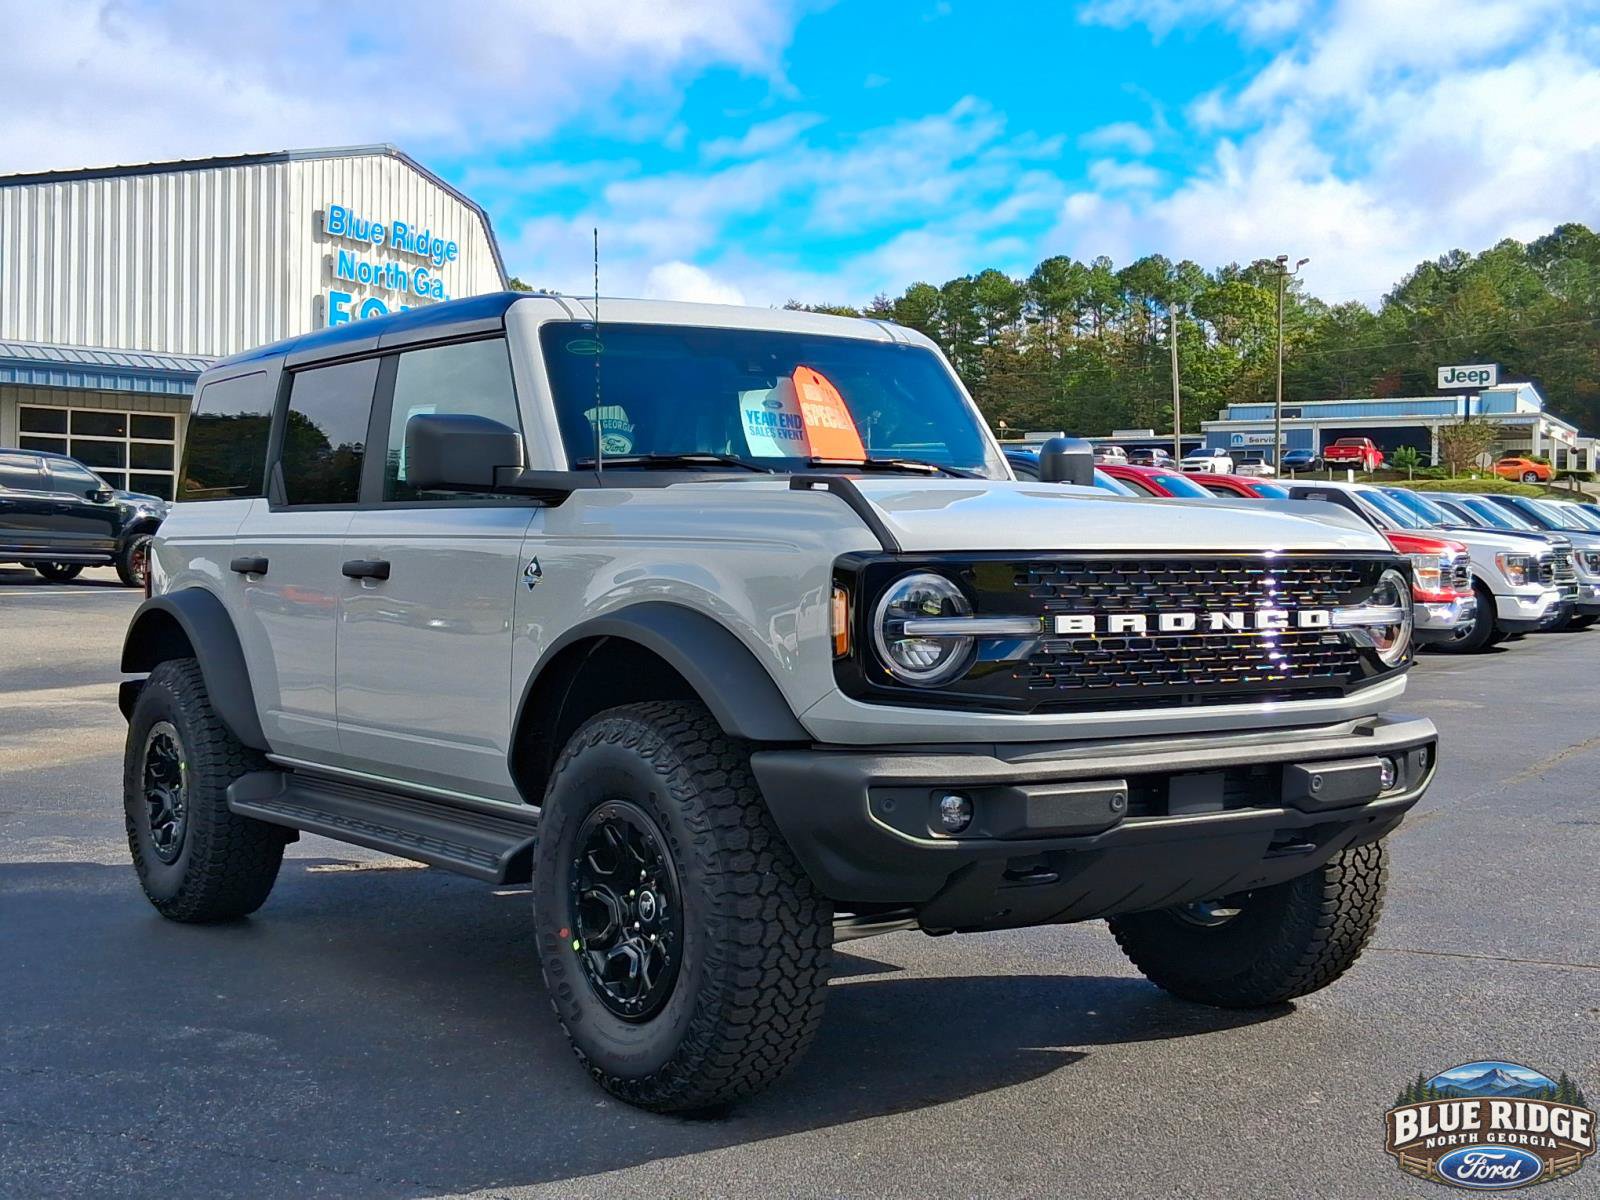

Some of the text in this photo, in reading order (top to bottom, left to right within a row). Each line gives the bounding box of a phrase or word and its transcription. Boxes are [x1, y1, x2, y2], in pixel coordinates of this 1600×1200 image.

[327, 204, 458, 267] Blue Ridge
[336, 248, 408, 293] North
[1443, 367, 1490, 385] Jeep
[745, 409, 803, 429] YEAR END
[749, 425, 804, 441] SALES EVENT
[1248, 436, 1282, 444] Servic
[1054, 609, 1331, 635] BRONCO
